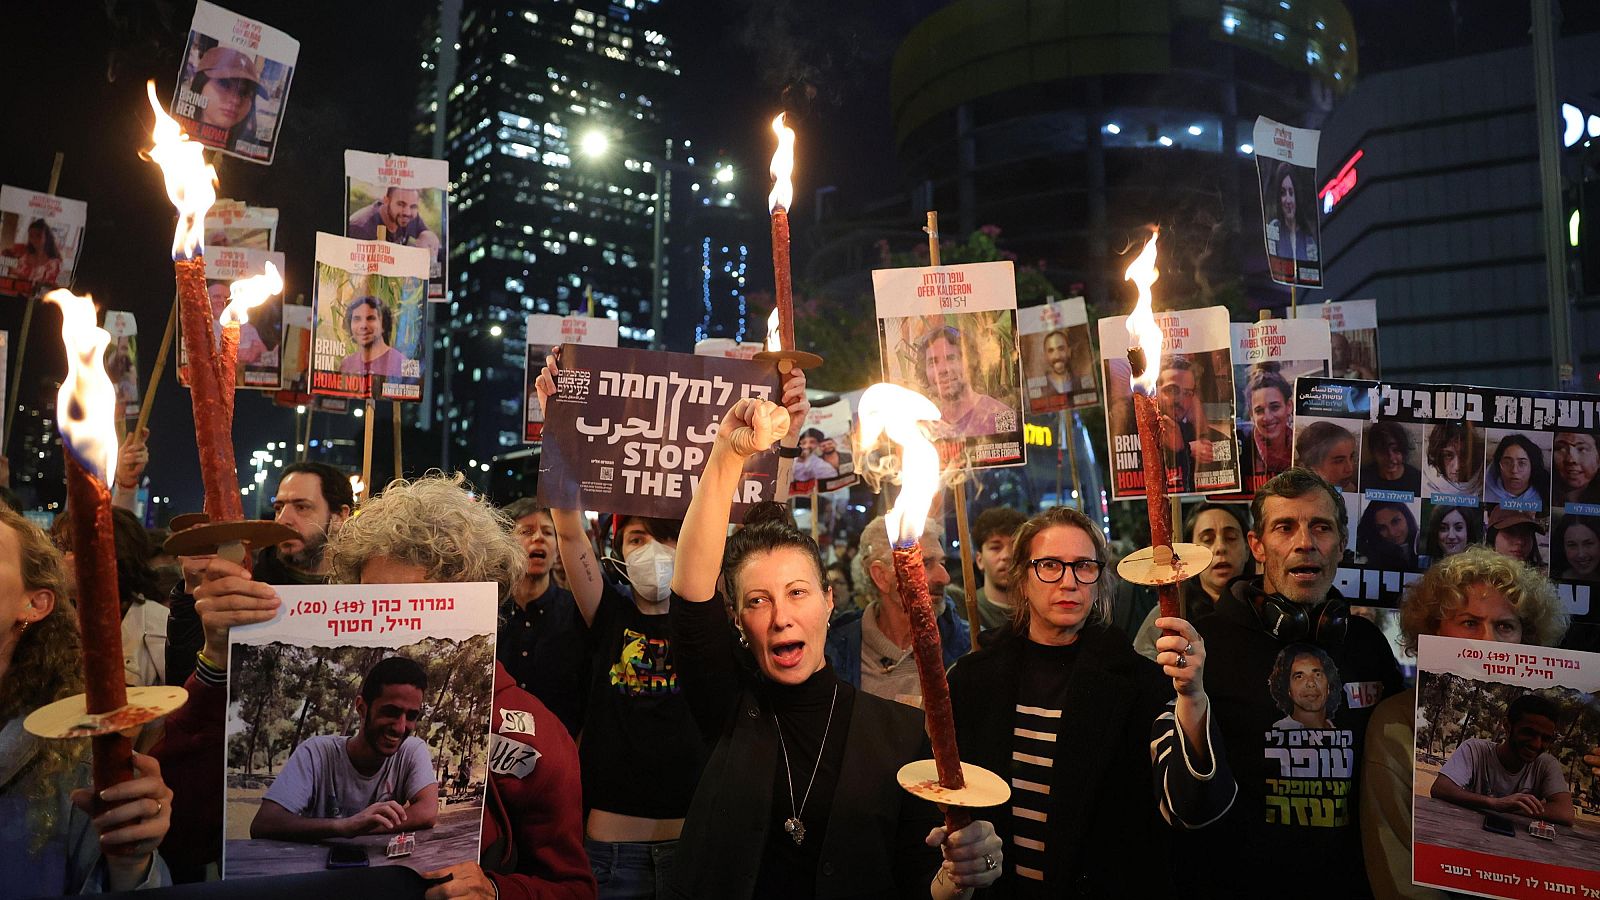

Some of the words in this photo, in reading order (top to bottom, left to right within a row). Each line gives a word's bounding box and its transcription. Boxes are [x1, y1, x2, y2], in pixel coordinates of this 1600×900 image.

[946, 271, 965, 284] עופר
[917, 285, 936, 298] OFER
[937, 283, 972, 297] KALDERON
[1169, 327, 1190, 338] COHEN
[1260, 335, 1287, 347] YEHOUD
[315, 338, 346, 359] BRING
[1245, 348, 1264, 361] (29)
[314, 354, 335, 371] HIM
[313, 372, 343, 390] HOME
[345, 375, 372, 392] NOW!
[598, 371, 734, 407] למלחמה
[1367, 384, 1484, 424] בשבילן
[1494, 394, 1600, 431] ועקות
[1115, 434, 1142, 453] BRIN
[623, 441, 704, 471] STOP
[1116, 451, 1139, 470] HIM
[621, 469, 683, 498] THE
[1117, 470, 1146, 489] HOM
[289, 600, 328, 617] (20),
[333, 600, 366, 615] (19)
[371, 599, 402, 617] כהן
[408, 597, 455, 611] נמרוד
[327, 618, 373, 637] חטוף
[379, 616, 422, 634] חייל,
[1486, 650, 1511, 663] (19)
[1514, 653, 1538, 666] כהן
[1542, 656, 1581, 670] נמרוד
[1482, 663, 1517, 676] חטוף
[1520, 665, 1554, 680] חייל,
[504, 711, 527, 733] 98
[1264, 729, 1286, 747] לי
[1289, 730, 1353, 748] קוראים
[491, 740, 537, 771] 467
[1264, 747, 1354, 778] עופר
[1265, 795, 1350, 828] בעזה
[1440, 863, 1472, 877] בשבי
[1475, 868, 1522, 885] להשאר
[1525, 876, 1540, 889] לו
[1543, 880, 1577, 895] תתנו
